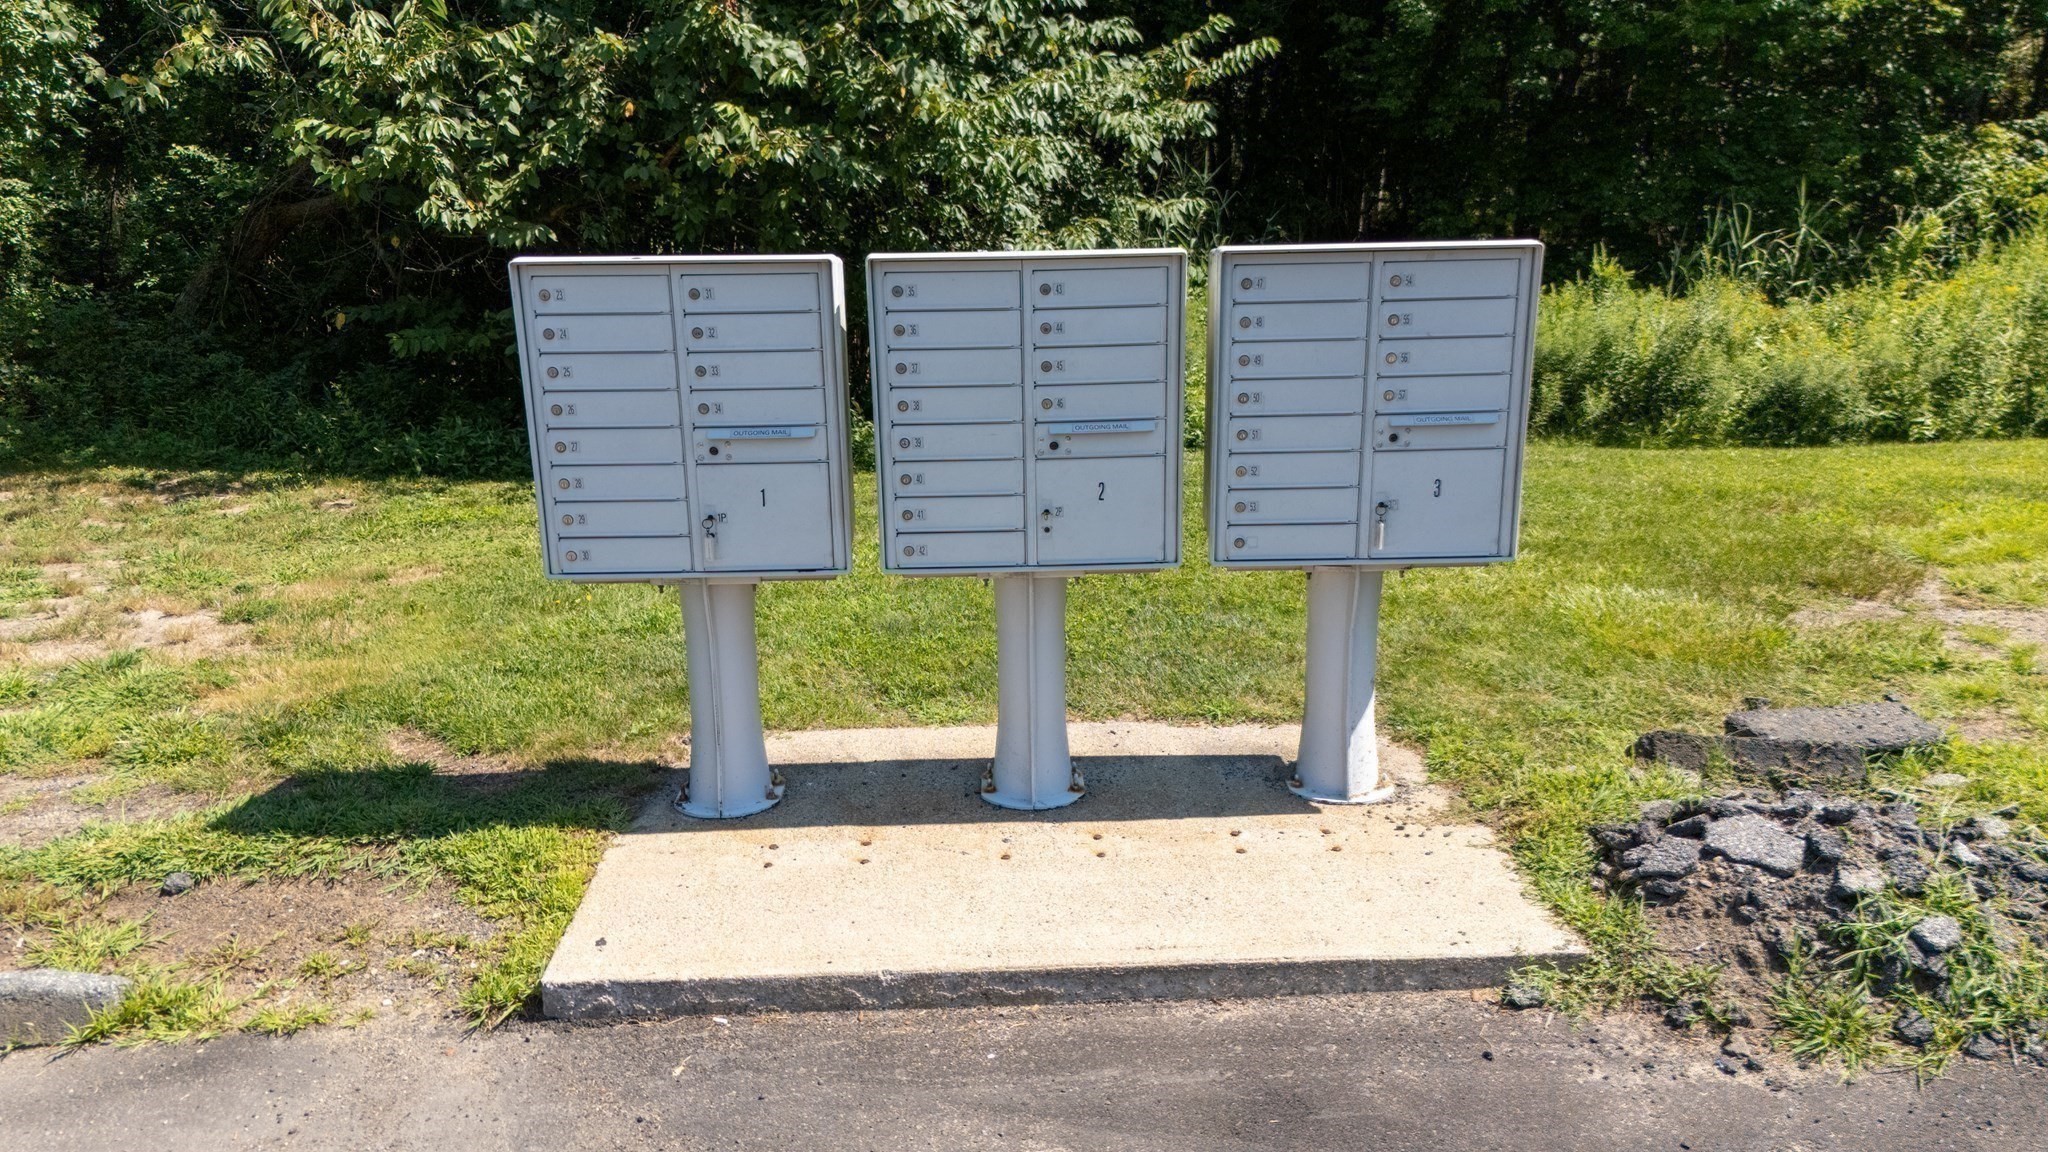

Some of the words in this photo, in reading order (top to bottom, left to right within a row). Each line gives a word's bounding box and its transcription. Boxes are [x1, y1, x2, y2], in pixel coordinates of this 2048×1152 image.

[1255, 278, 1263, 288] 47
[1405, 276, 1412, 286] 54
[705, 289, 713, 299] 31
[908, 286, 915, 297] 35
[1055, 284, 1063, 294] 43
[555, 289, 564, 300] 23
[1255, 317, 1263, 327] 48
[1403, 314, 1410, 325] 55
[708, 328, 715, 338] 32
[910, 325, 917, 335] 36
[1055, 323, 1063, 333] 44
[559, 329, 568, 339] 24
[1253, 355, 1261, 365] 49
[1400, 353, 1408, 363] 56
[711, 366, 719, 376] 33
[911, 363, 918, 374] 37
[1056, 361, 1063, 371] 45
[563, 367, 571, 377] 25
[1252, 393, 1260, 403] 50
[1398, 390, 1406, 400] 57
[913, 400, 920, 411] 38
[1056, 398, 1064, 408] 46
[567, 405, 575, 415] 26
[714, 404, 722, 414] 34
[733, 429, 770, 437] OUTGOING
[1251, 430, 1259, 440] 51
[571, 442, 578, 452] 27
[914, 438, 922, 448] 39
[1250, 466, 1258, 476] 52
[574, 478, 582, 489] 28
[915, 474, 923, 484] 40
[1098, 482, 1104, 501] 2
[1433, 479, 1441, 497] 3
[760, 488, 766, 507] 1
[1249, 502, 1257, 512] 53
[578, 514, 586, 524] 29
[718, 513, 727, 522] 1P
[917, 510, 924, 519] 41
[582, 550, 589, 561] 30
[918, 546, 926, 556] 42
